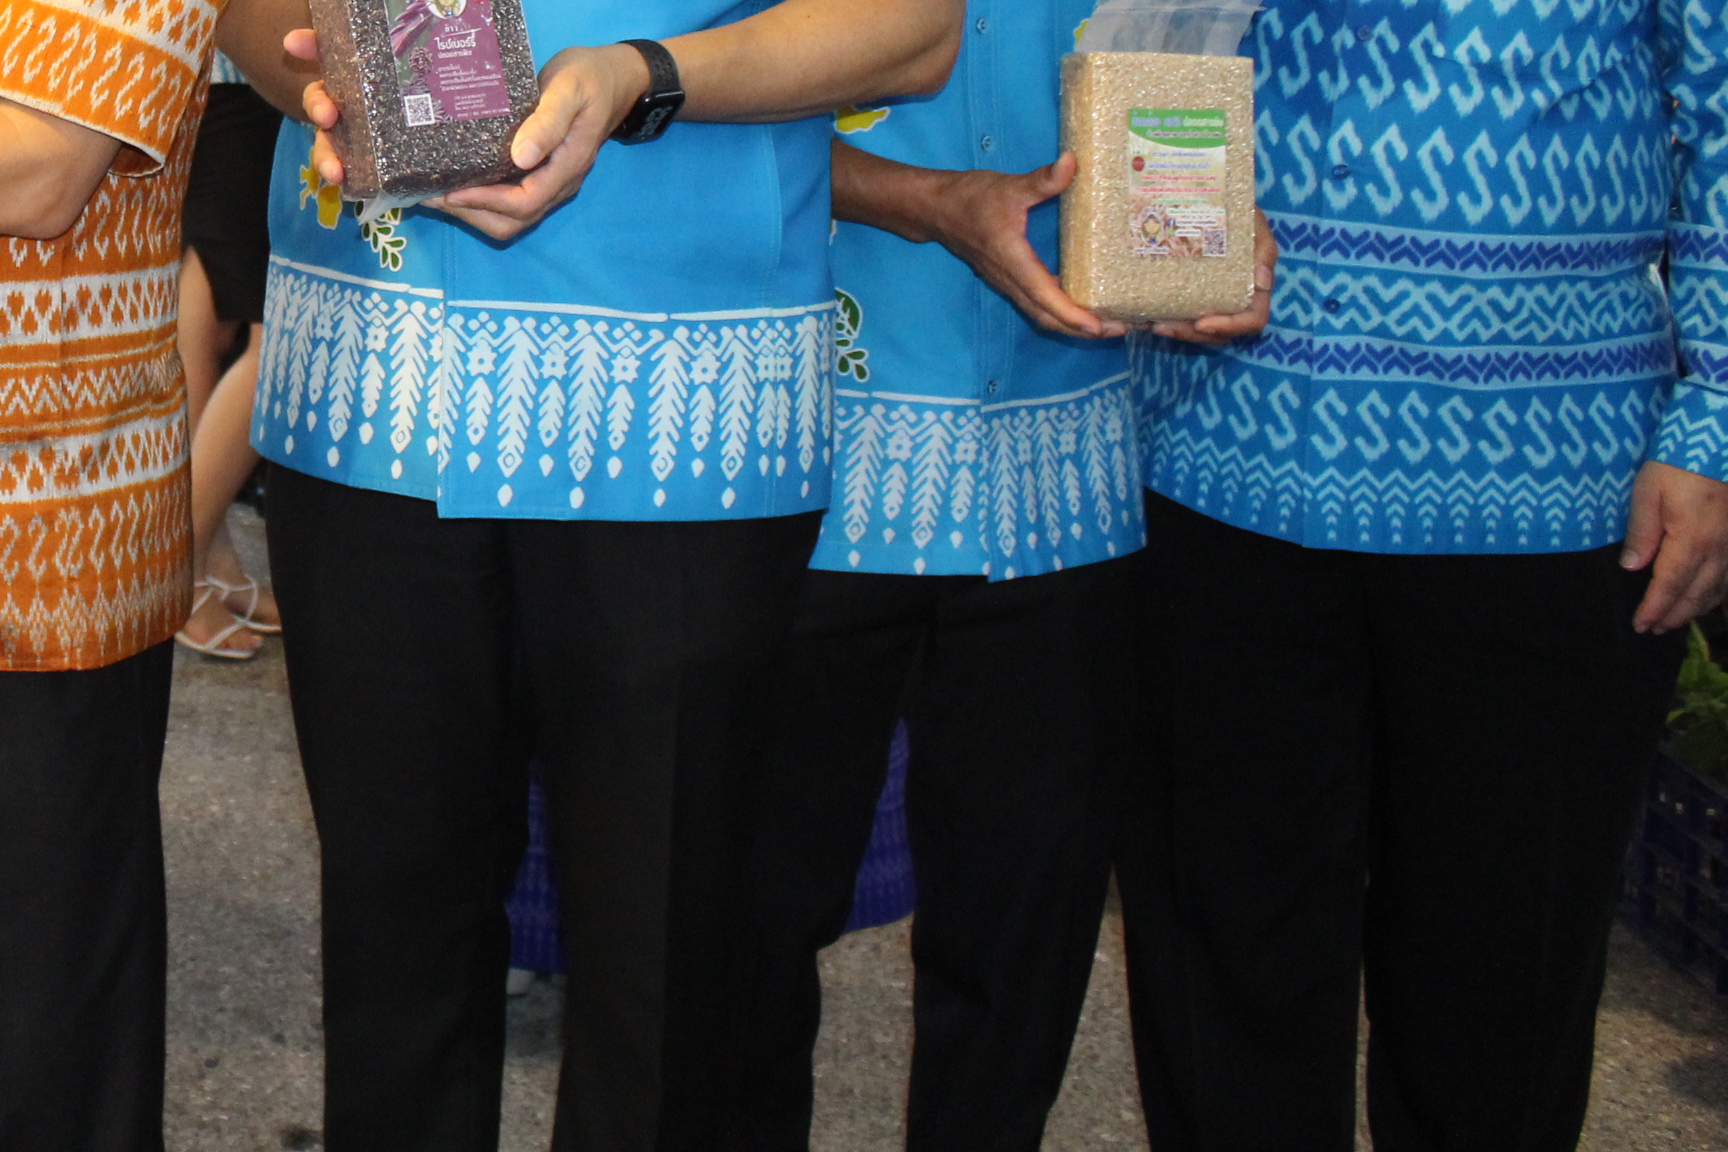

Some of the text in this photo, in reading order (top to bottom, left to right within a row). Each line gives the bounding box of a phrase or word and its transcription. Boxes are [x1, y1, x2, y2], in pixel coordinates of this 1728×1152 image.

[432, 29, 476, 50] ไรซ์เบอร์รี่
